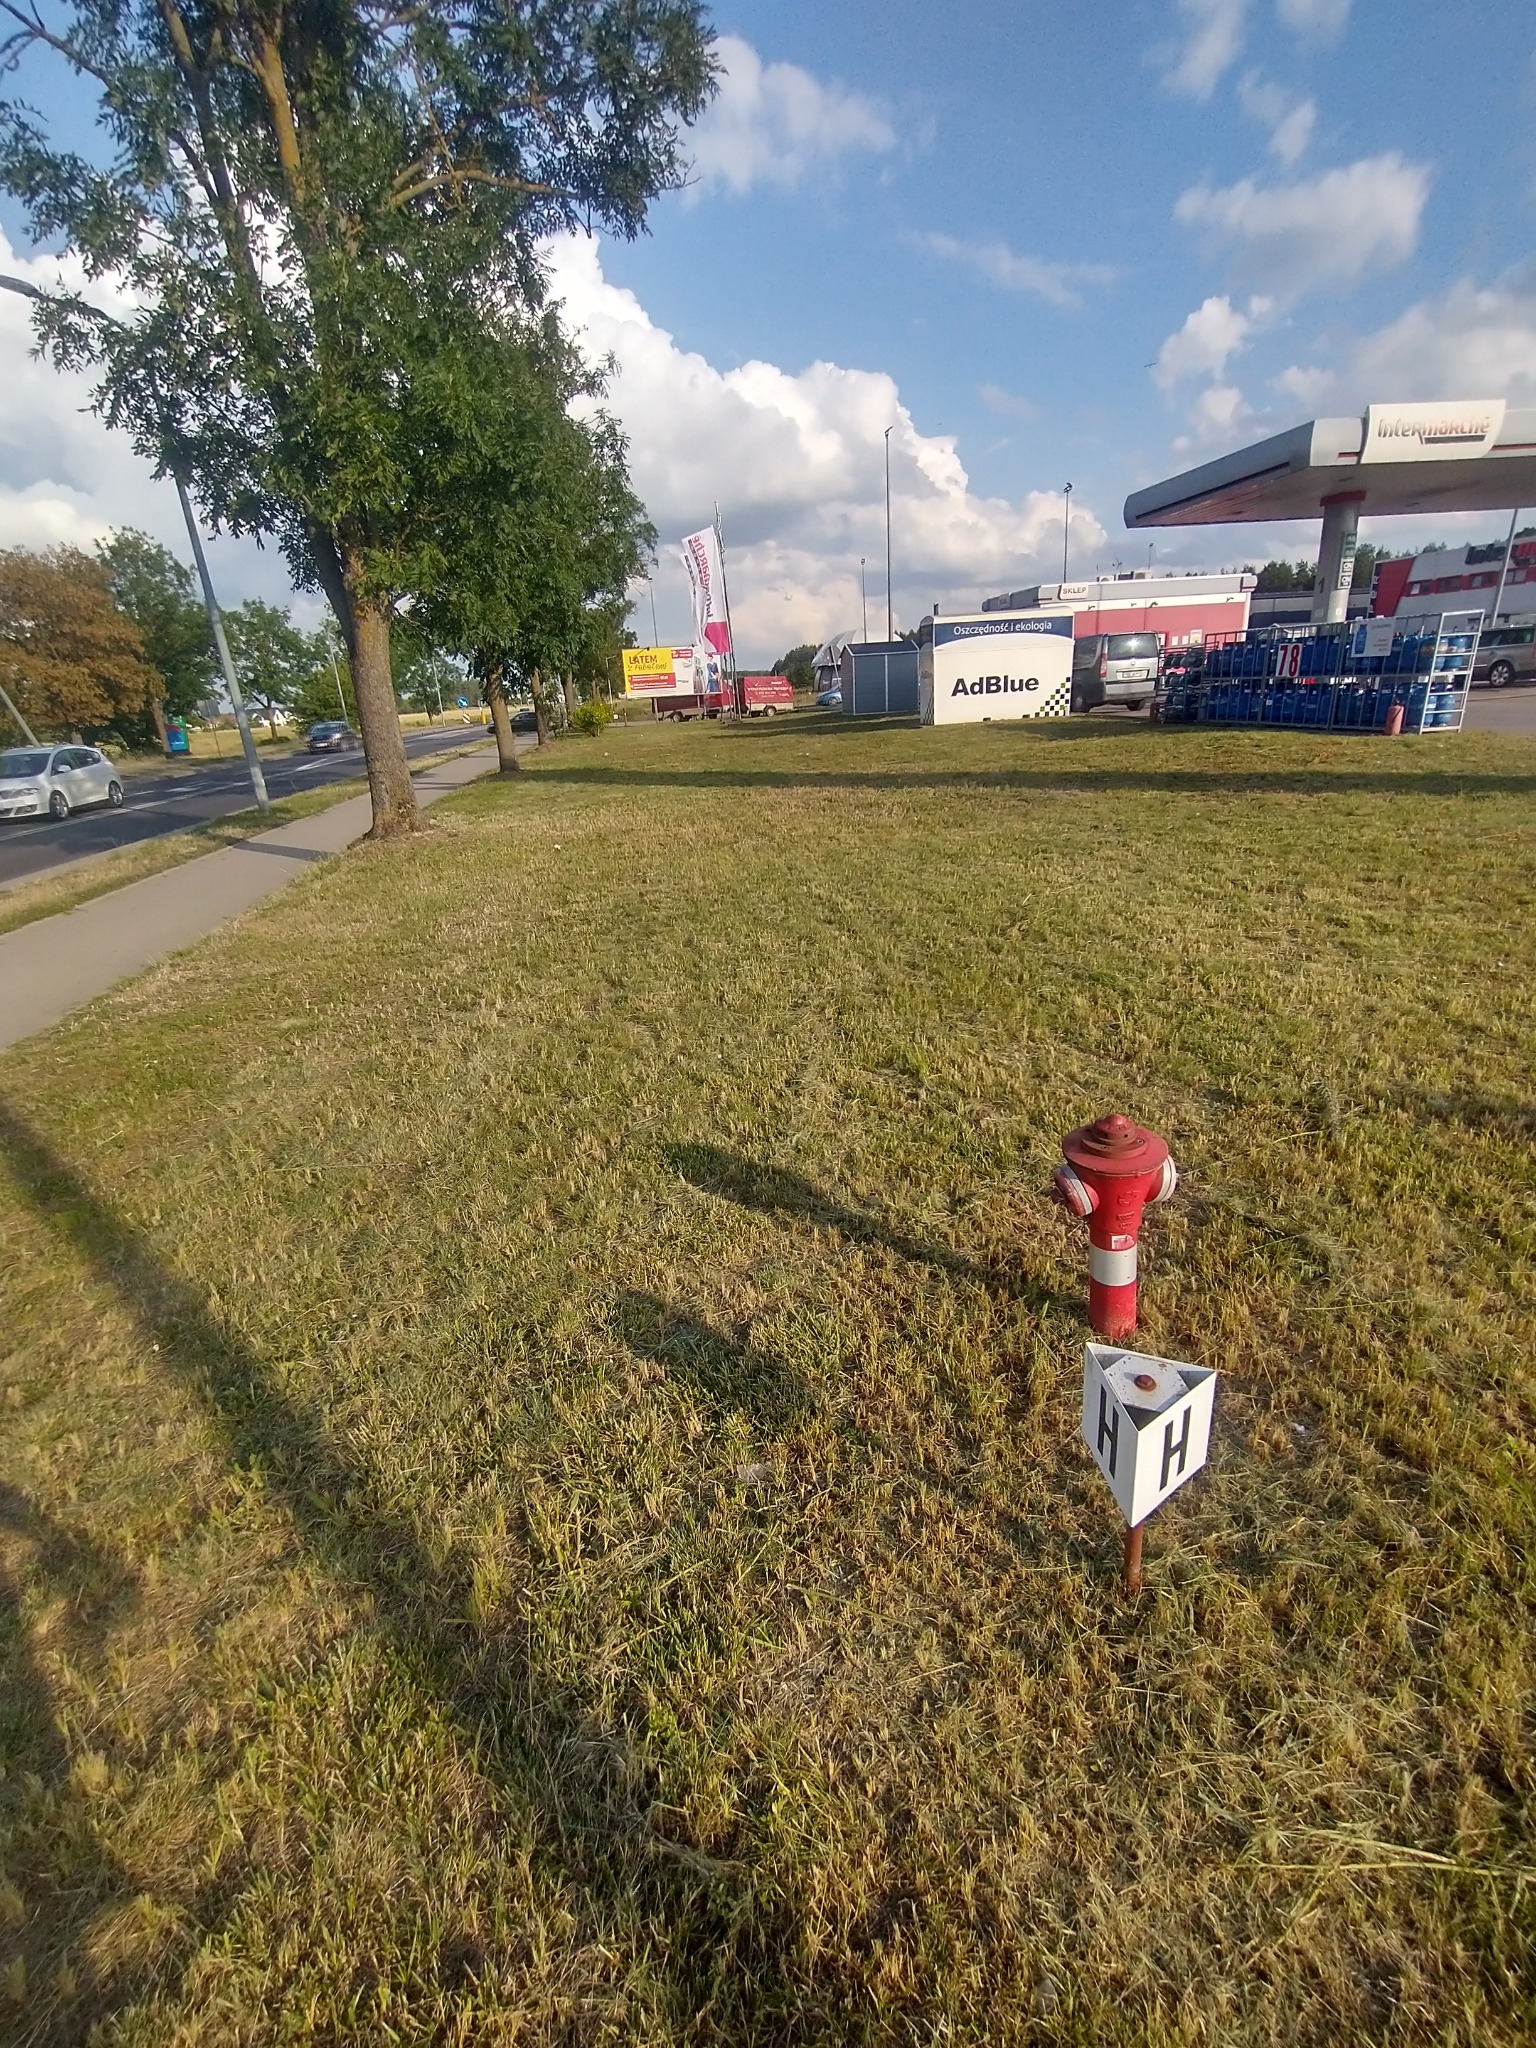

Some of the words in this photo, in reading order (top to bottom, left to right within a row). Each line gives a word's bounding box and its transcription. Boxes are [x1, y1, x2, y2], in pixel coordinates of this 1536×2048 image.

[1062, 586, 1087, 595] SKLEP
[953, 622, 1009, 636] Oszczędność
[1010, 622, 1014, 632] i
[1015, 620, 1052, 633] ekologia
[629, 655, 658, 665] LATEM
[1278, 644, 1300, 677] 78
[950, 675, 1040, 697] AdBlue
[1097, 1384, 1120, 1480] H
[1159, 1404, 1192, 1492] H
